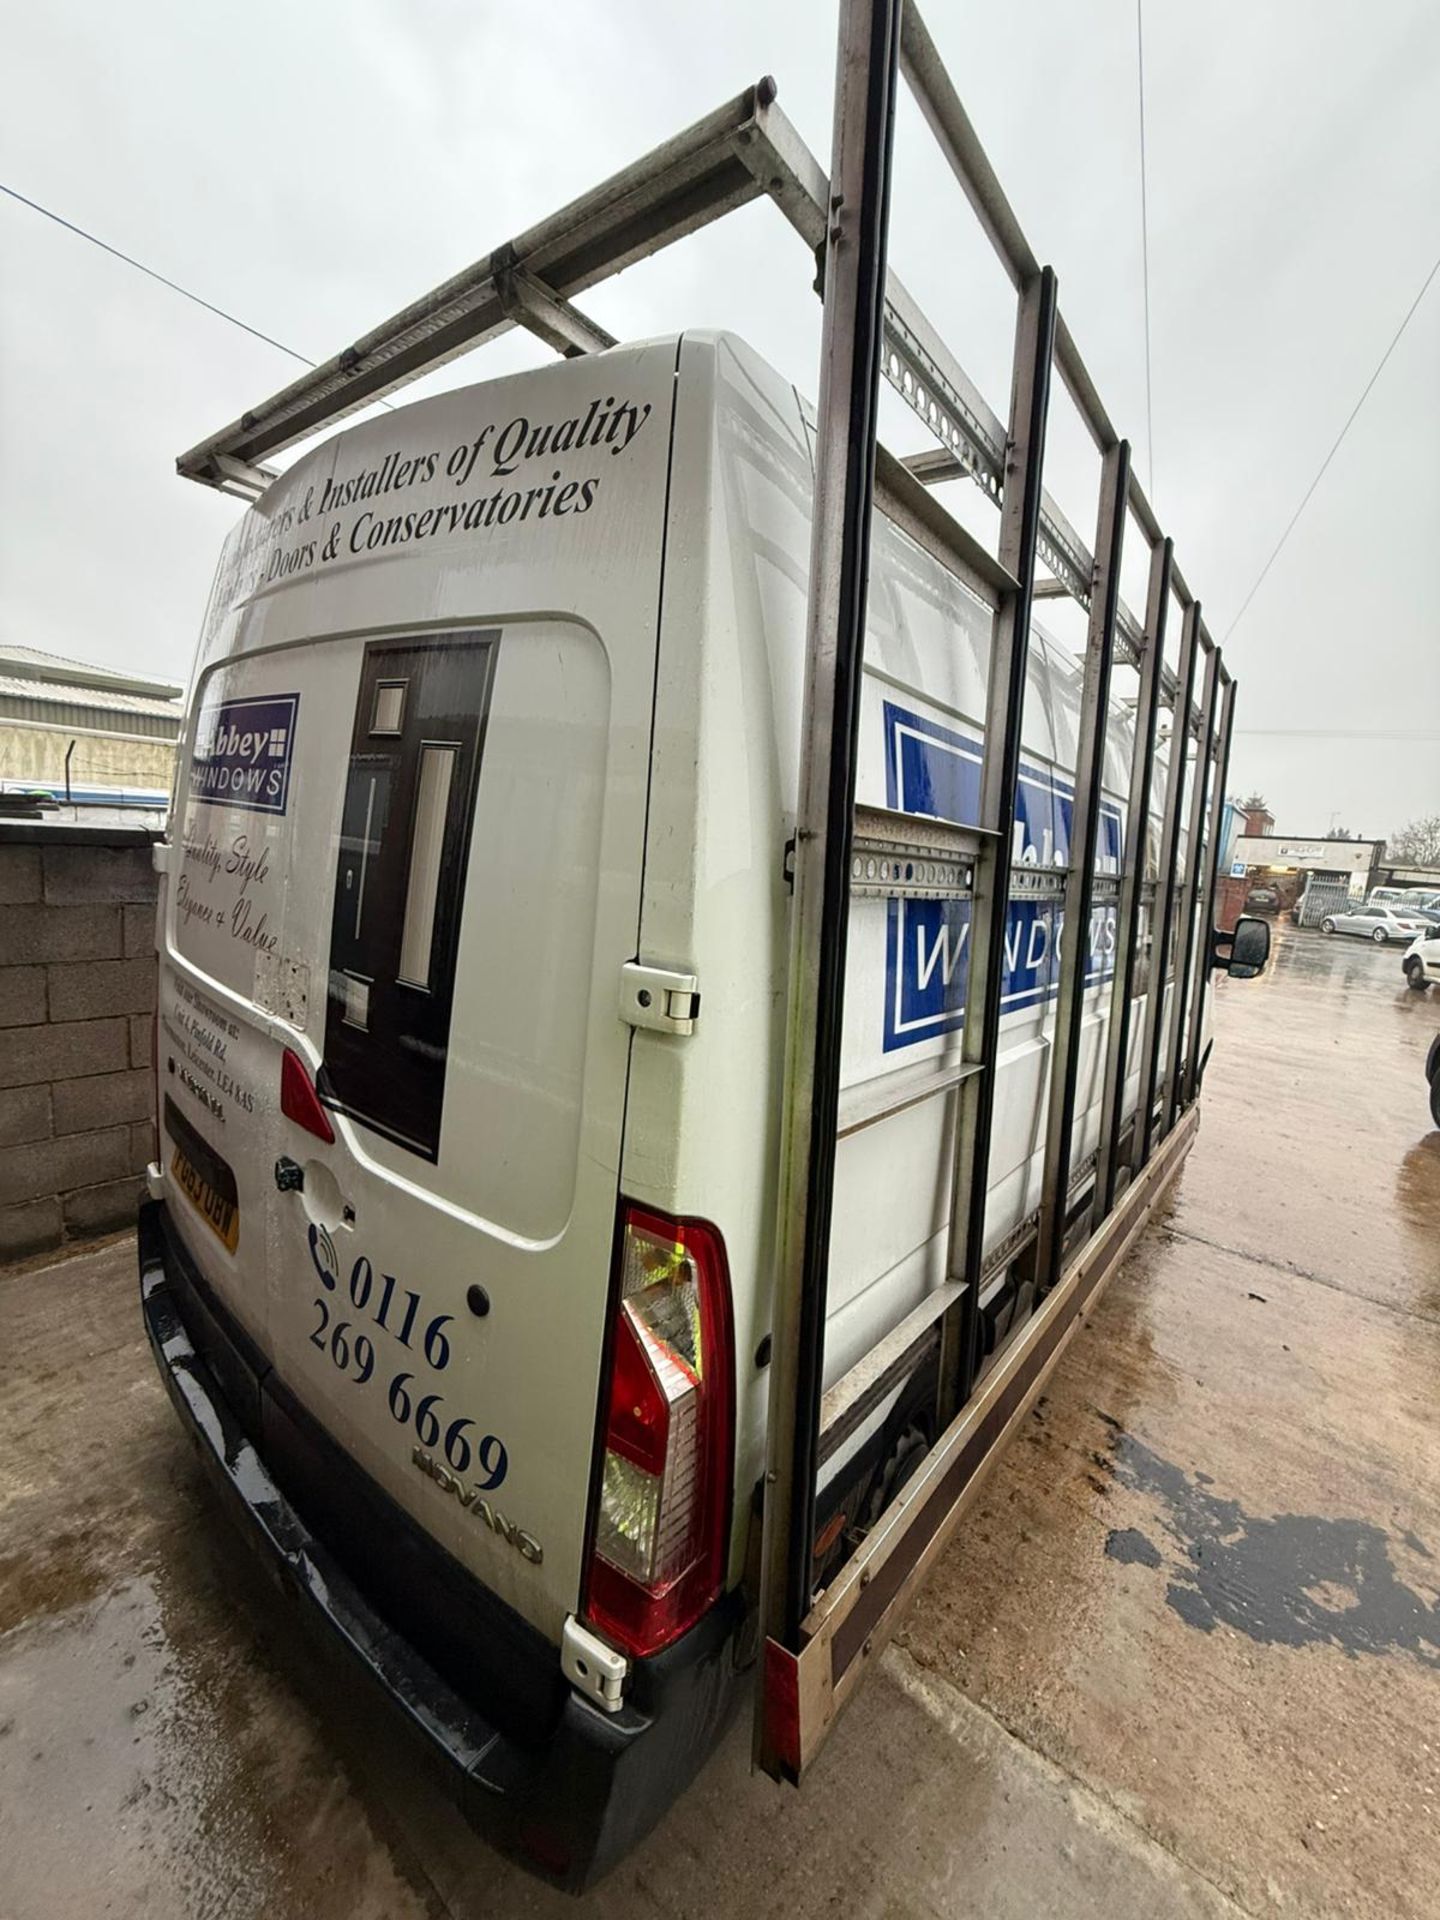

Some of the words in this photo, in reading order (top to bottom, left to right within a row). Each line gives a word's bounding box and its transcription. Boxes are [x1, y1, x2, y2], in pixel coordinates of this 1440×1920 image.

[298, 486, 315, 529] &
[317, 449, 441, 516] Installers
[446, 423, 494, 486] of
[492, 395, 653, 477] Quality
[267, 540, 318, 584] Doors
[321, 520, 342, 563] &
[349, 470, 601, 554] Conservatories
[191, 766, 283, 797] WINDOWS
[226, 834, 270, 896] Style
[232, 897, 279, 953] Value
[916, 918, 1116, 992] WNDWS
[349, 1254, 455, 1372] 0116
[308, 1297, 376, 1385] 269
[387, 1371, 510, 1492] 6669
